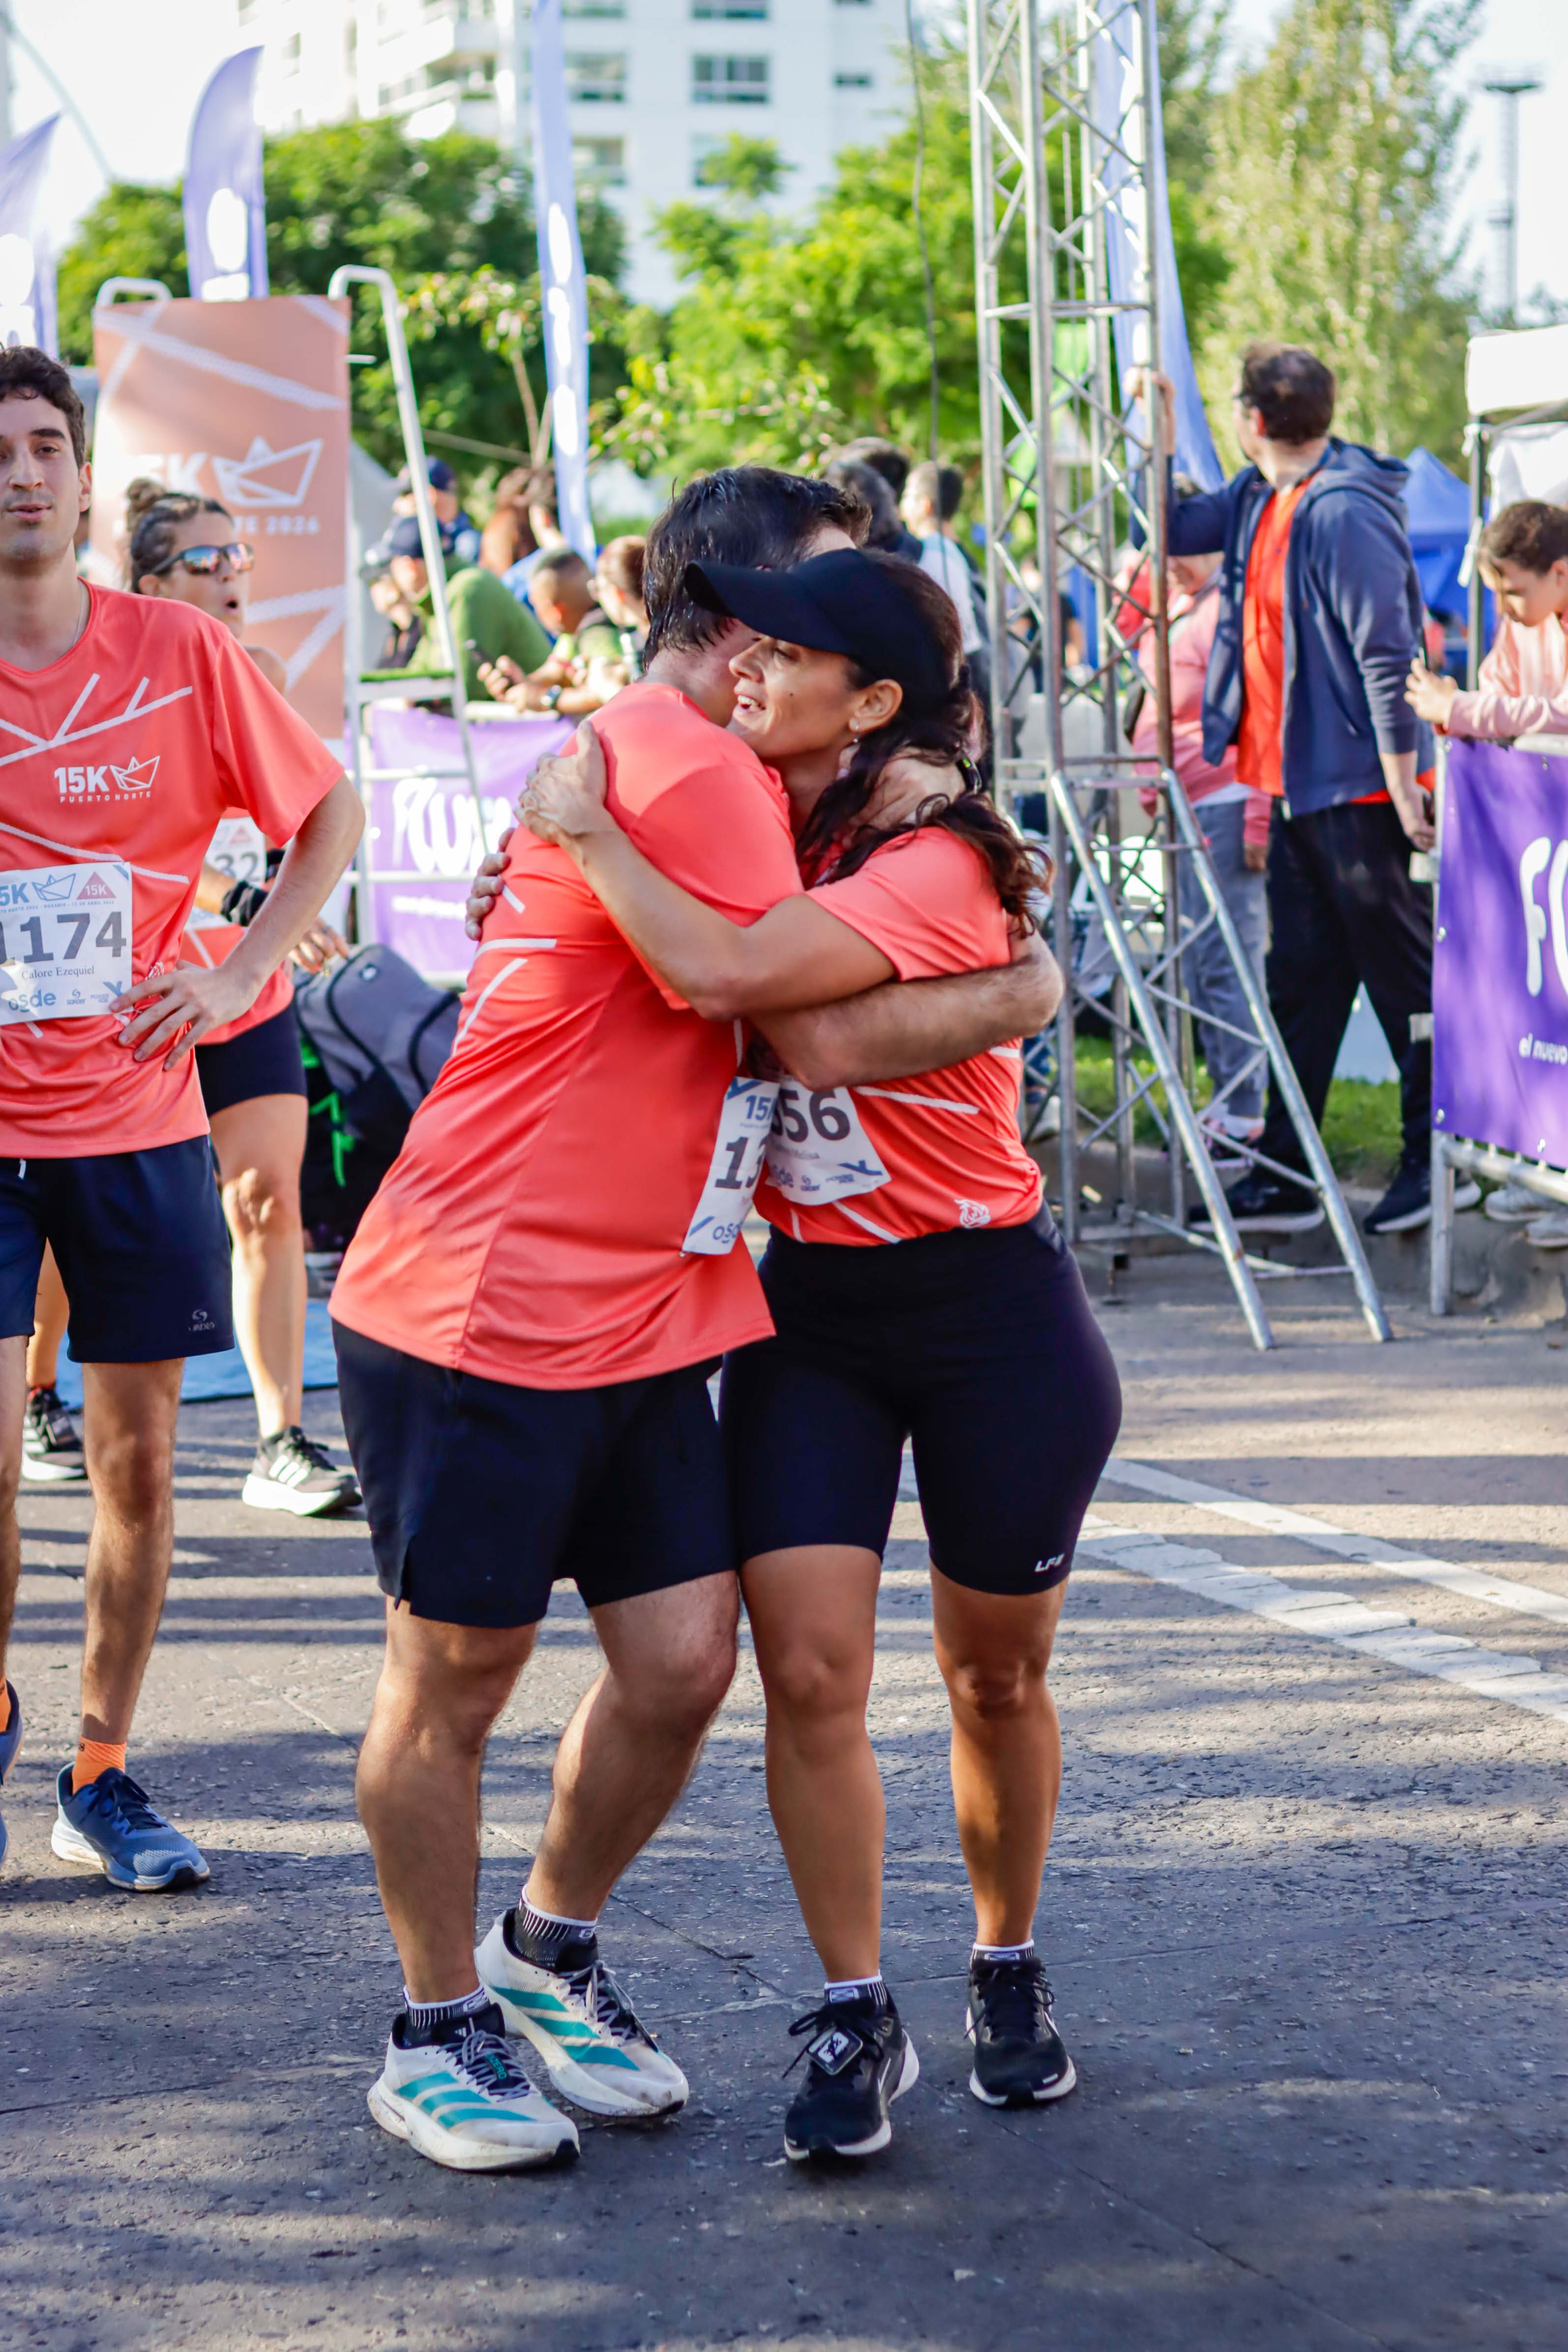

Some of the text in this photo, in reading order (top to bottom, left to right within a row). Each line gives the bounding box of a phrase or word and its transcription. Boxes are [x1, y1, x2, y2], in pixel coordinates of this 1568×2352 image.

[54, 765, 110, 794] 15K
[60, 791, 151, 803] PUERTO NORTE
[86, 884, 108, 896] 15K
[22, 965, 95, 980] Calore Ezequiel
[8, 988, 57, 1013] osde
[1518, 1032, 1568, 1066] el nuevo
